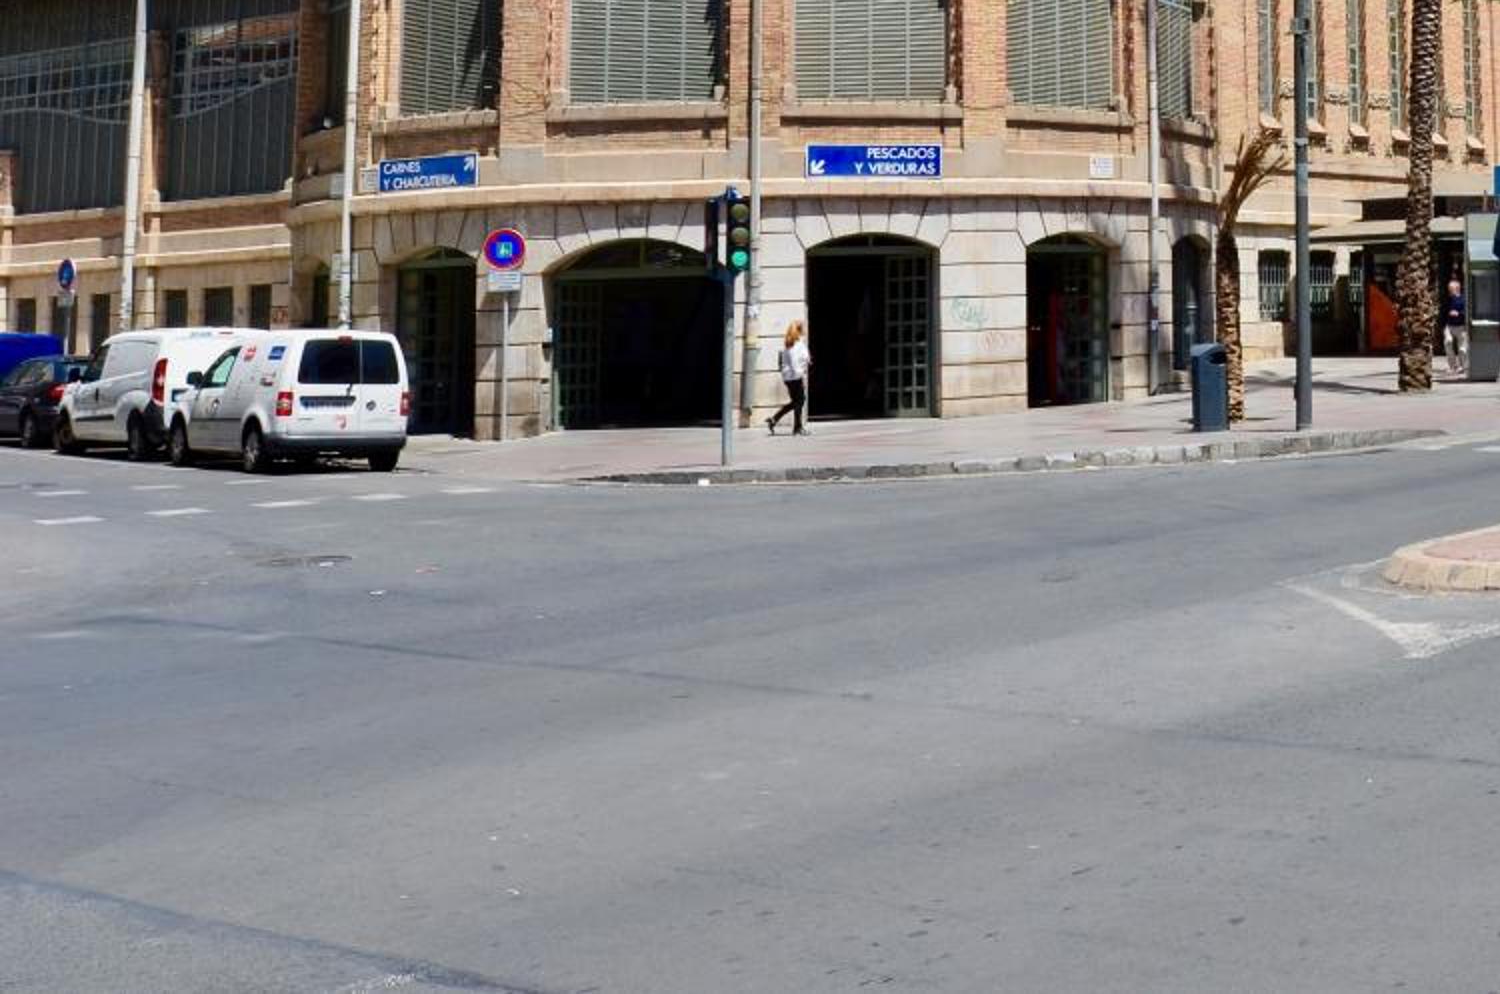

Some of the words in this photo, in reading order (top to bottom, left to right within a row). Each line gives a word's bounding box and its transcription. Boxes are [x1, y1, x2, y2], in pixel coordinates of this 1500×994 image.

[867, 147, 937, 159] PESCADOS
[383, 161, 421, 175] CARNES
[855, 162, 864, 175] Y
[868, 162, 937, 175] VERDURAS
[383, 177, 391, 191] Y
